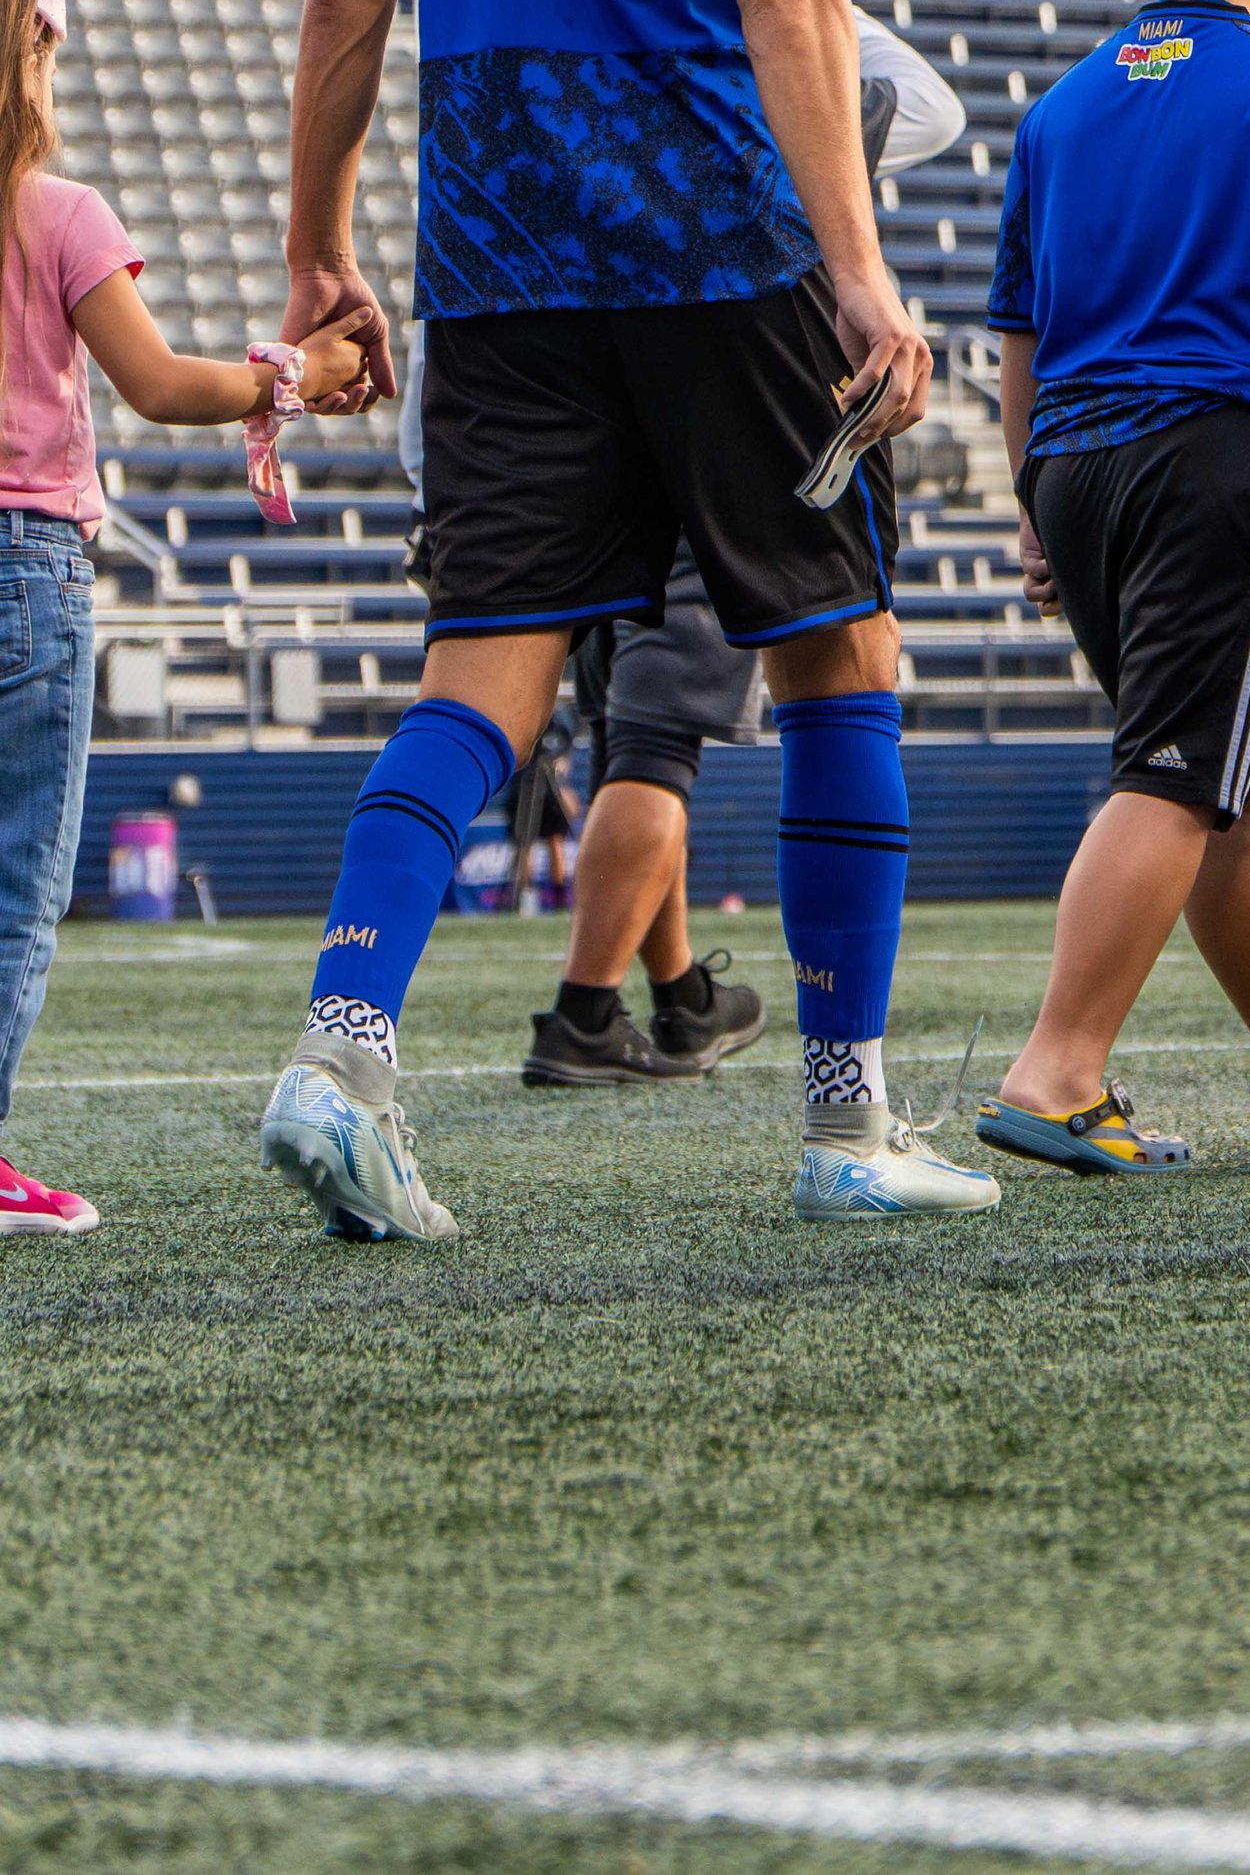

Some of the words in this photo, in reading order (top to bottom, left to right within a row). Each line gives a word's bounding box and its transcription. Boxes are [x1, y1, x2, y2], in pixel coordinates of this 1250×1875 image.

[1138, 19, 1184, 41] MIAMI
[1129, 62, 1171, 79] BUM
[1147, 757, 1188, 771] adidas
